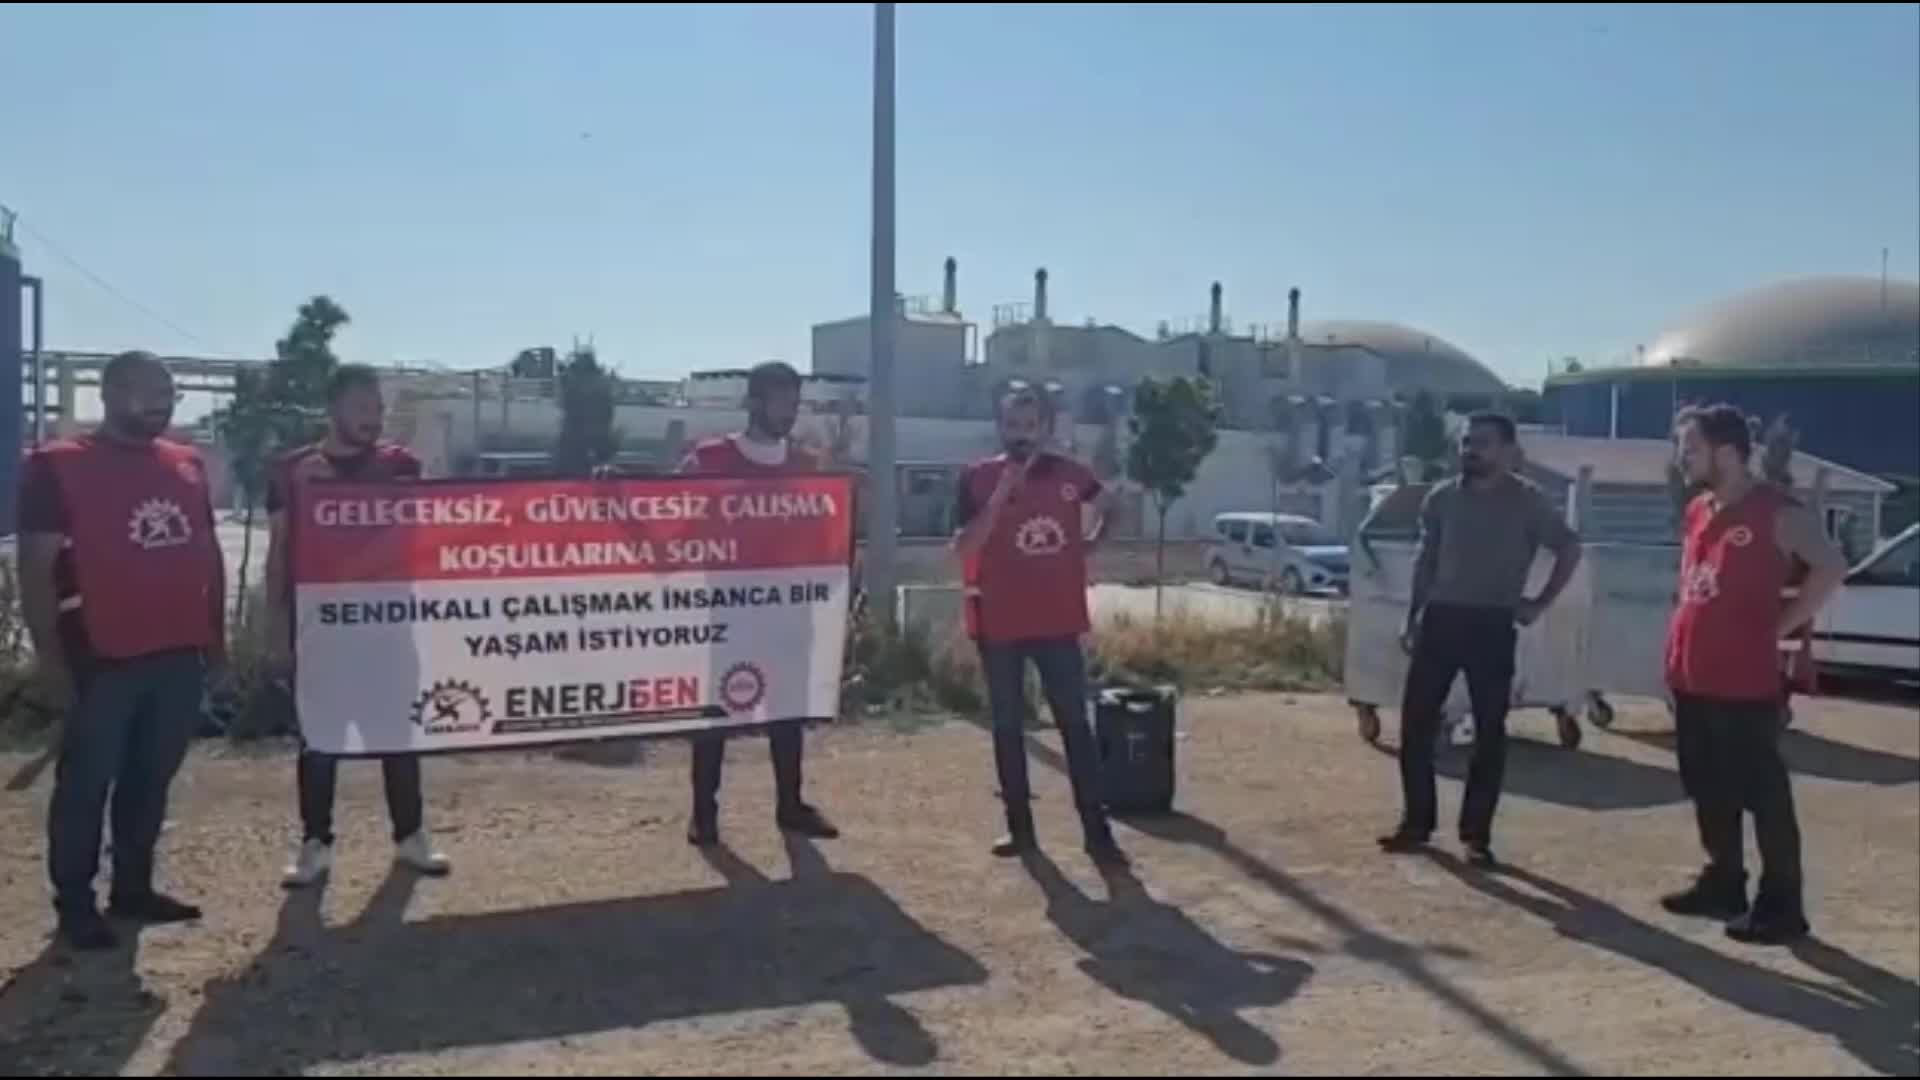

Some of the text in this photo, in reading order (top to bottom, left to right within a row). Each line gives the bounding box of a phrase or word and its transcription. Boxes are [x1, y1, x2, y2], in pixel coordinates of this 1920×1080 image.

[314, 491, 836, 527] GELECEKSİZ, GÜVENCESİZ ÇALIŞMA
[439, 538, 737, 574] KOŞULLARINA SON!
[319, 579, 829, 624] SENDİKALI ÇALIŞMAK İNSANCA BİR
[464, 624, 728, 659] YAŞAM İSTİYORUZ
